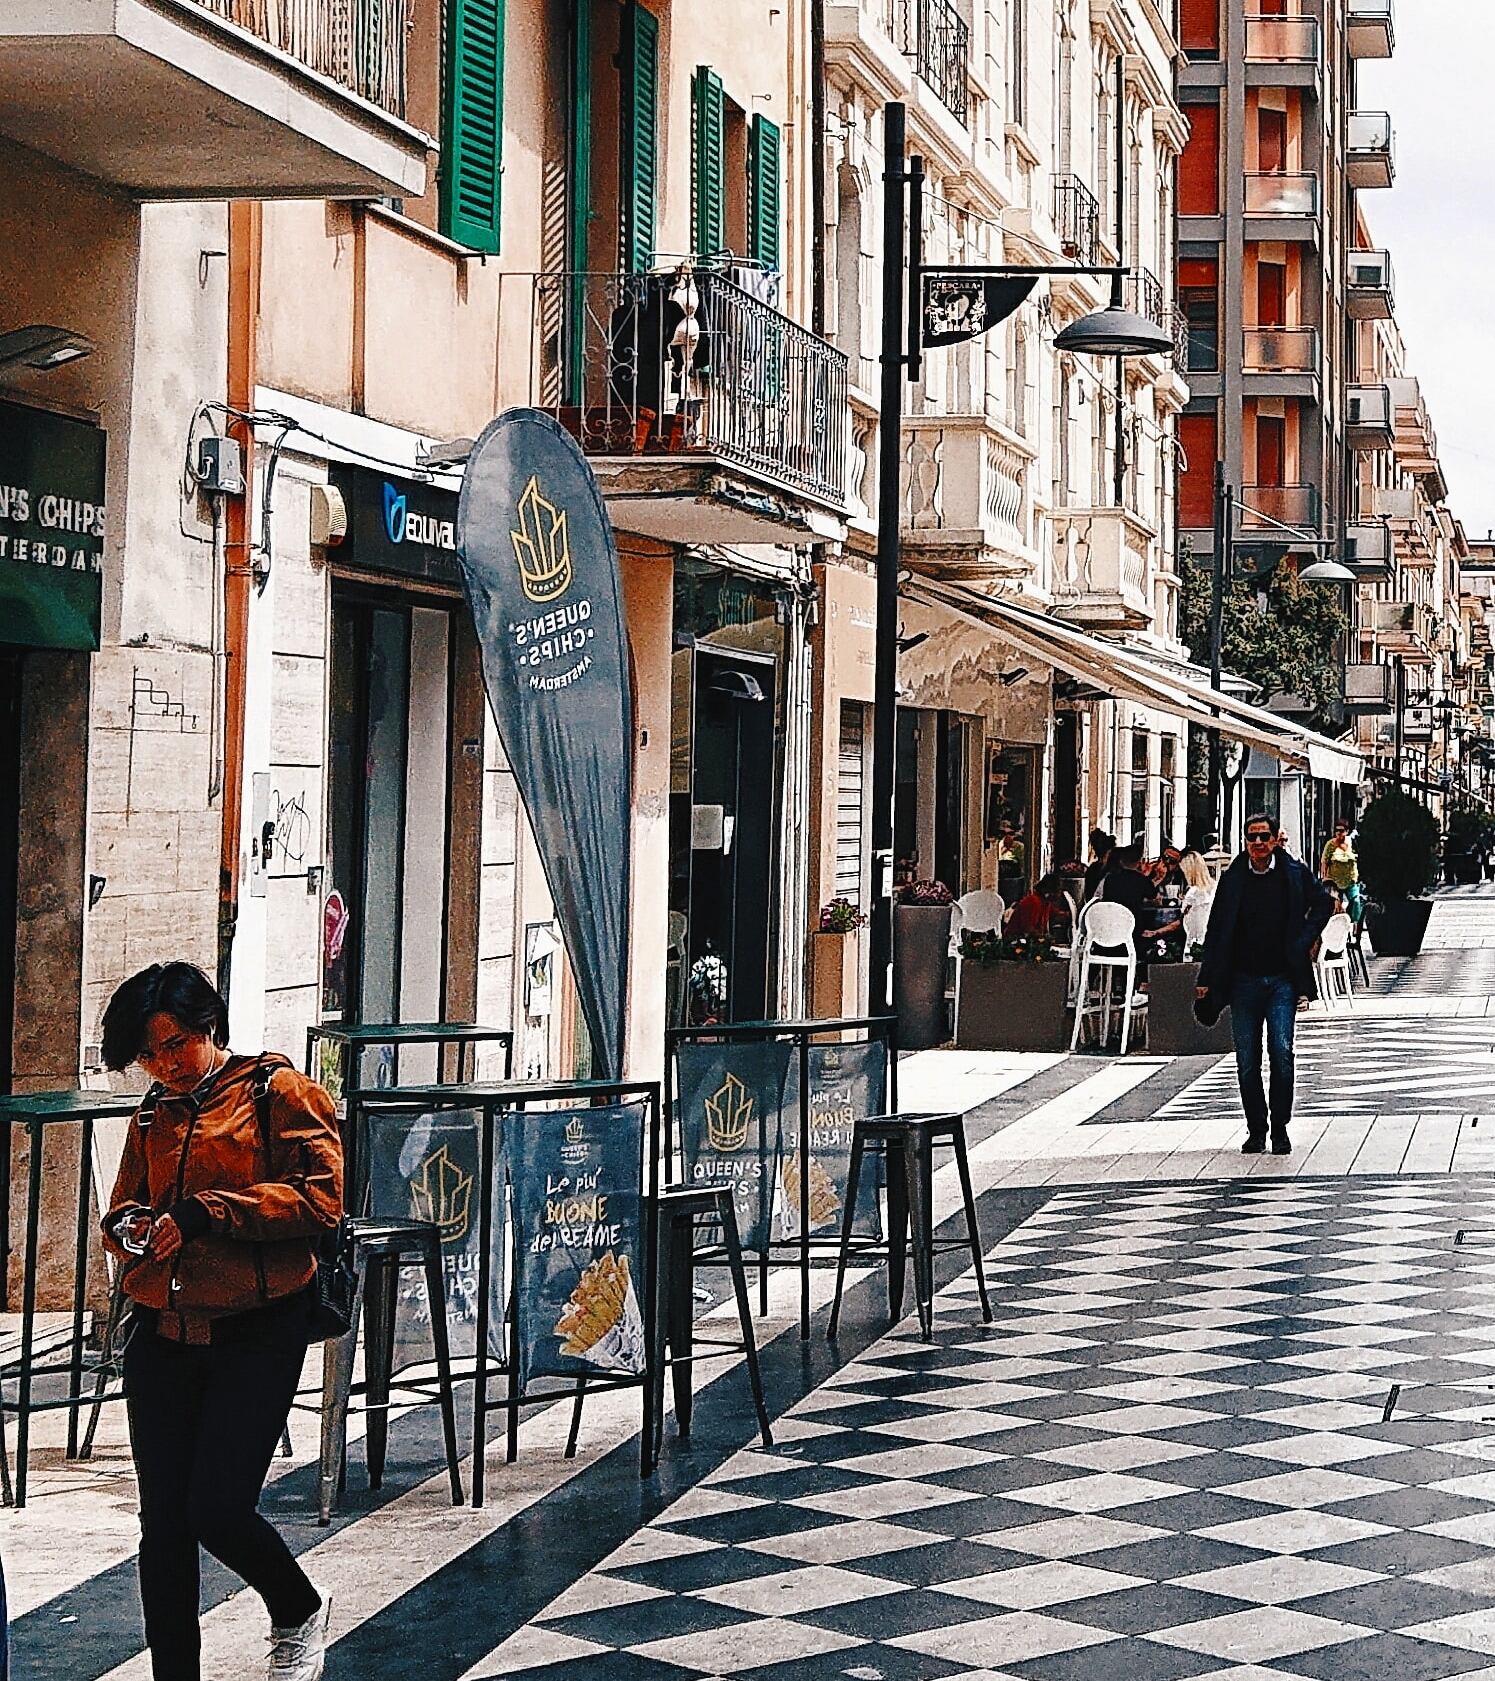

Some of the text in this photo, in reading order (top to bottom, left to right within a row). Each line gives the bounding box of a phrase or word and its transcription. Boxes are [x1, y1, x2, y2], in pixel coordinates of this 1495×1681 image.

[38, 495, 106, 537] CHIPS
[693, 1160, 762, 1179] QUEEN'S
[544, 1195, 609, 1226] BUONE
